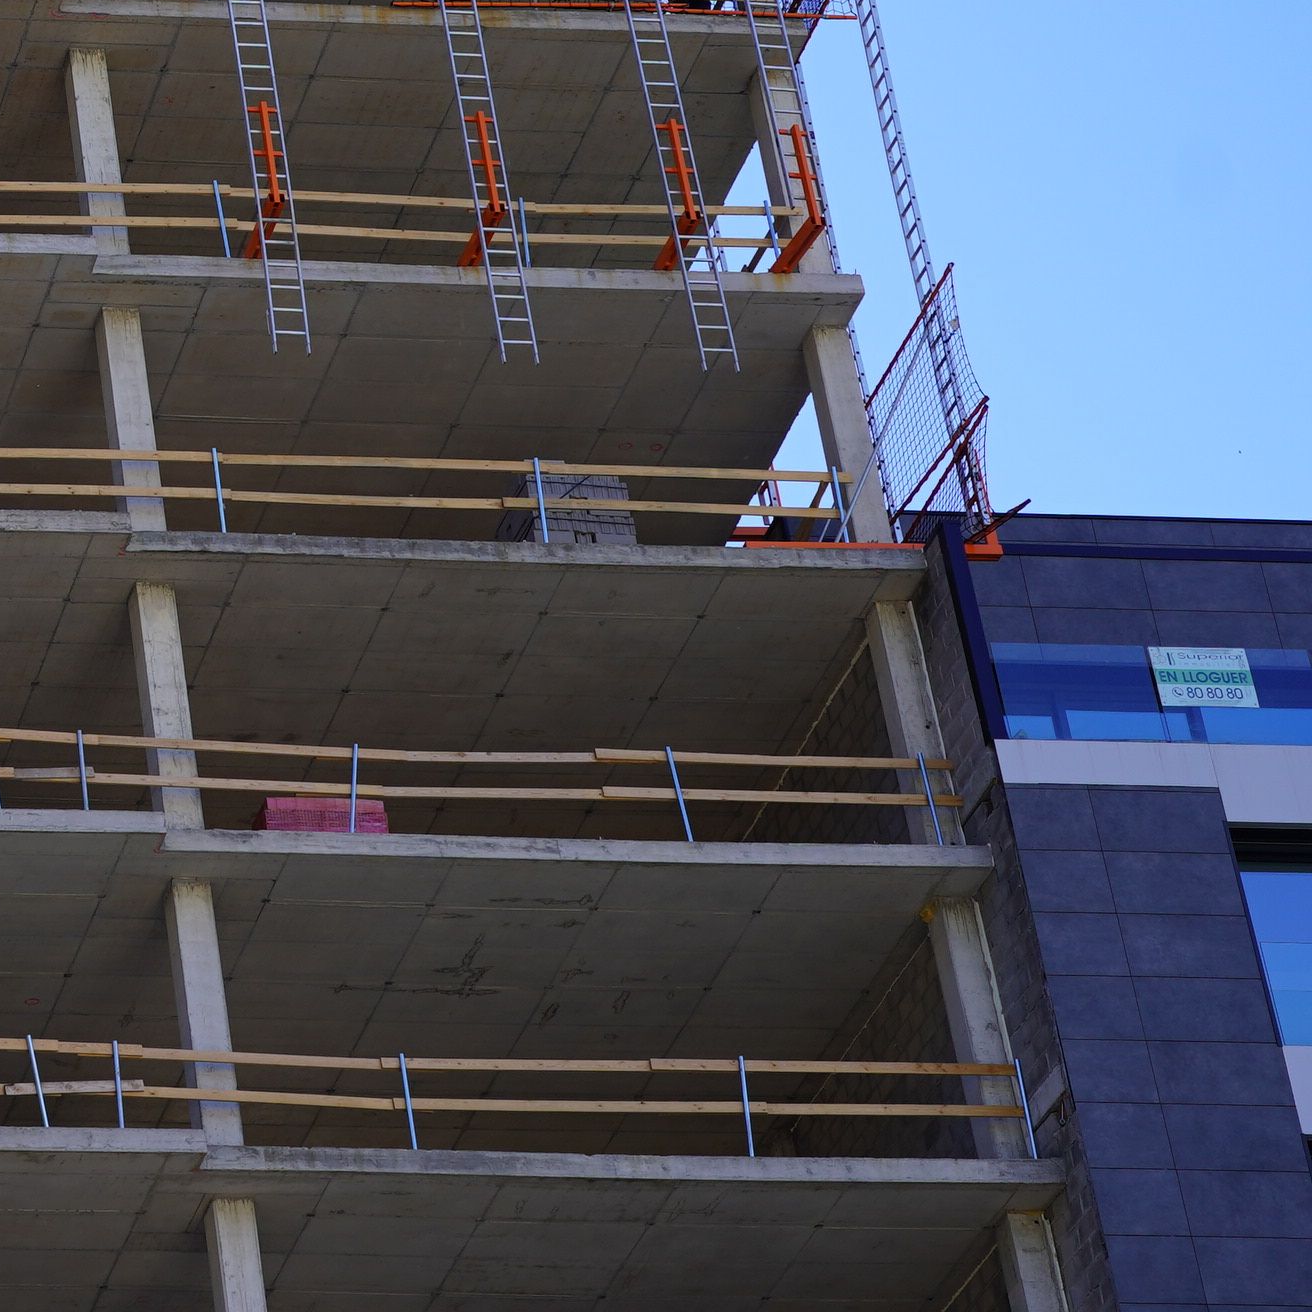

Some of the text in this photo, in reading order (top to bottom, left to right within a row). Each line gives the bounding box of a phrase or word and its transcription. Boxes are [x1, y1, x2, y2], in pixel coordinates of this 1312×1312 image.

[1158, 671, 1249, 684] EN LLOGUER
[1186, 686, 1244, 700] 80 80 80
